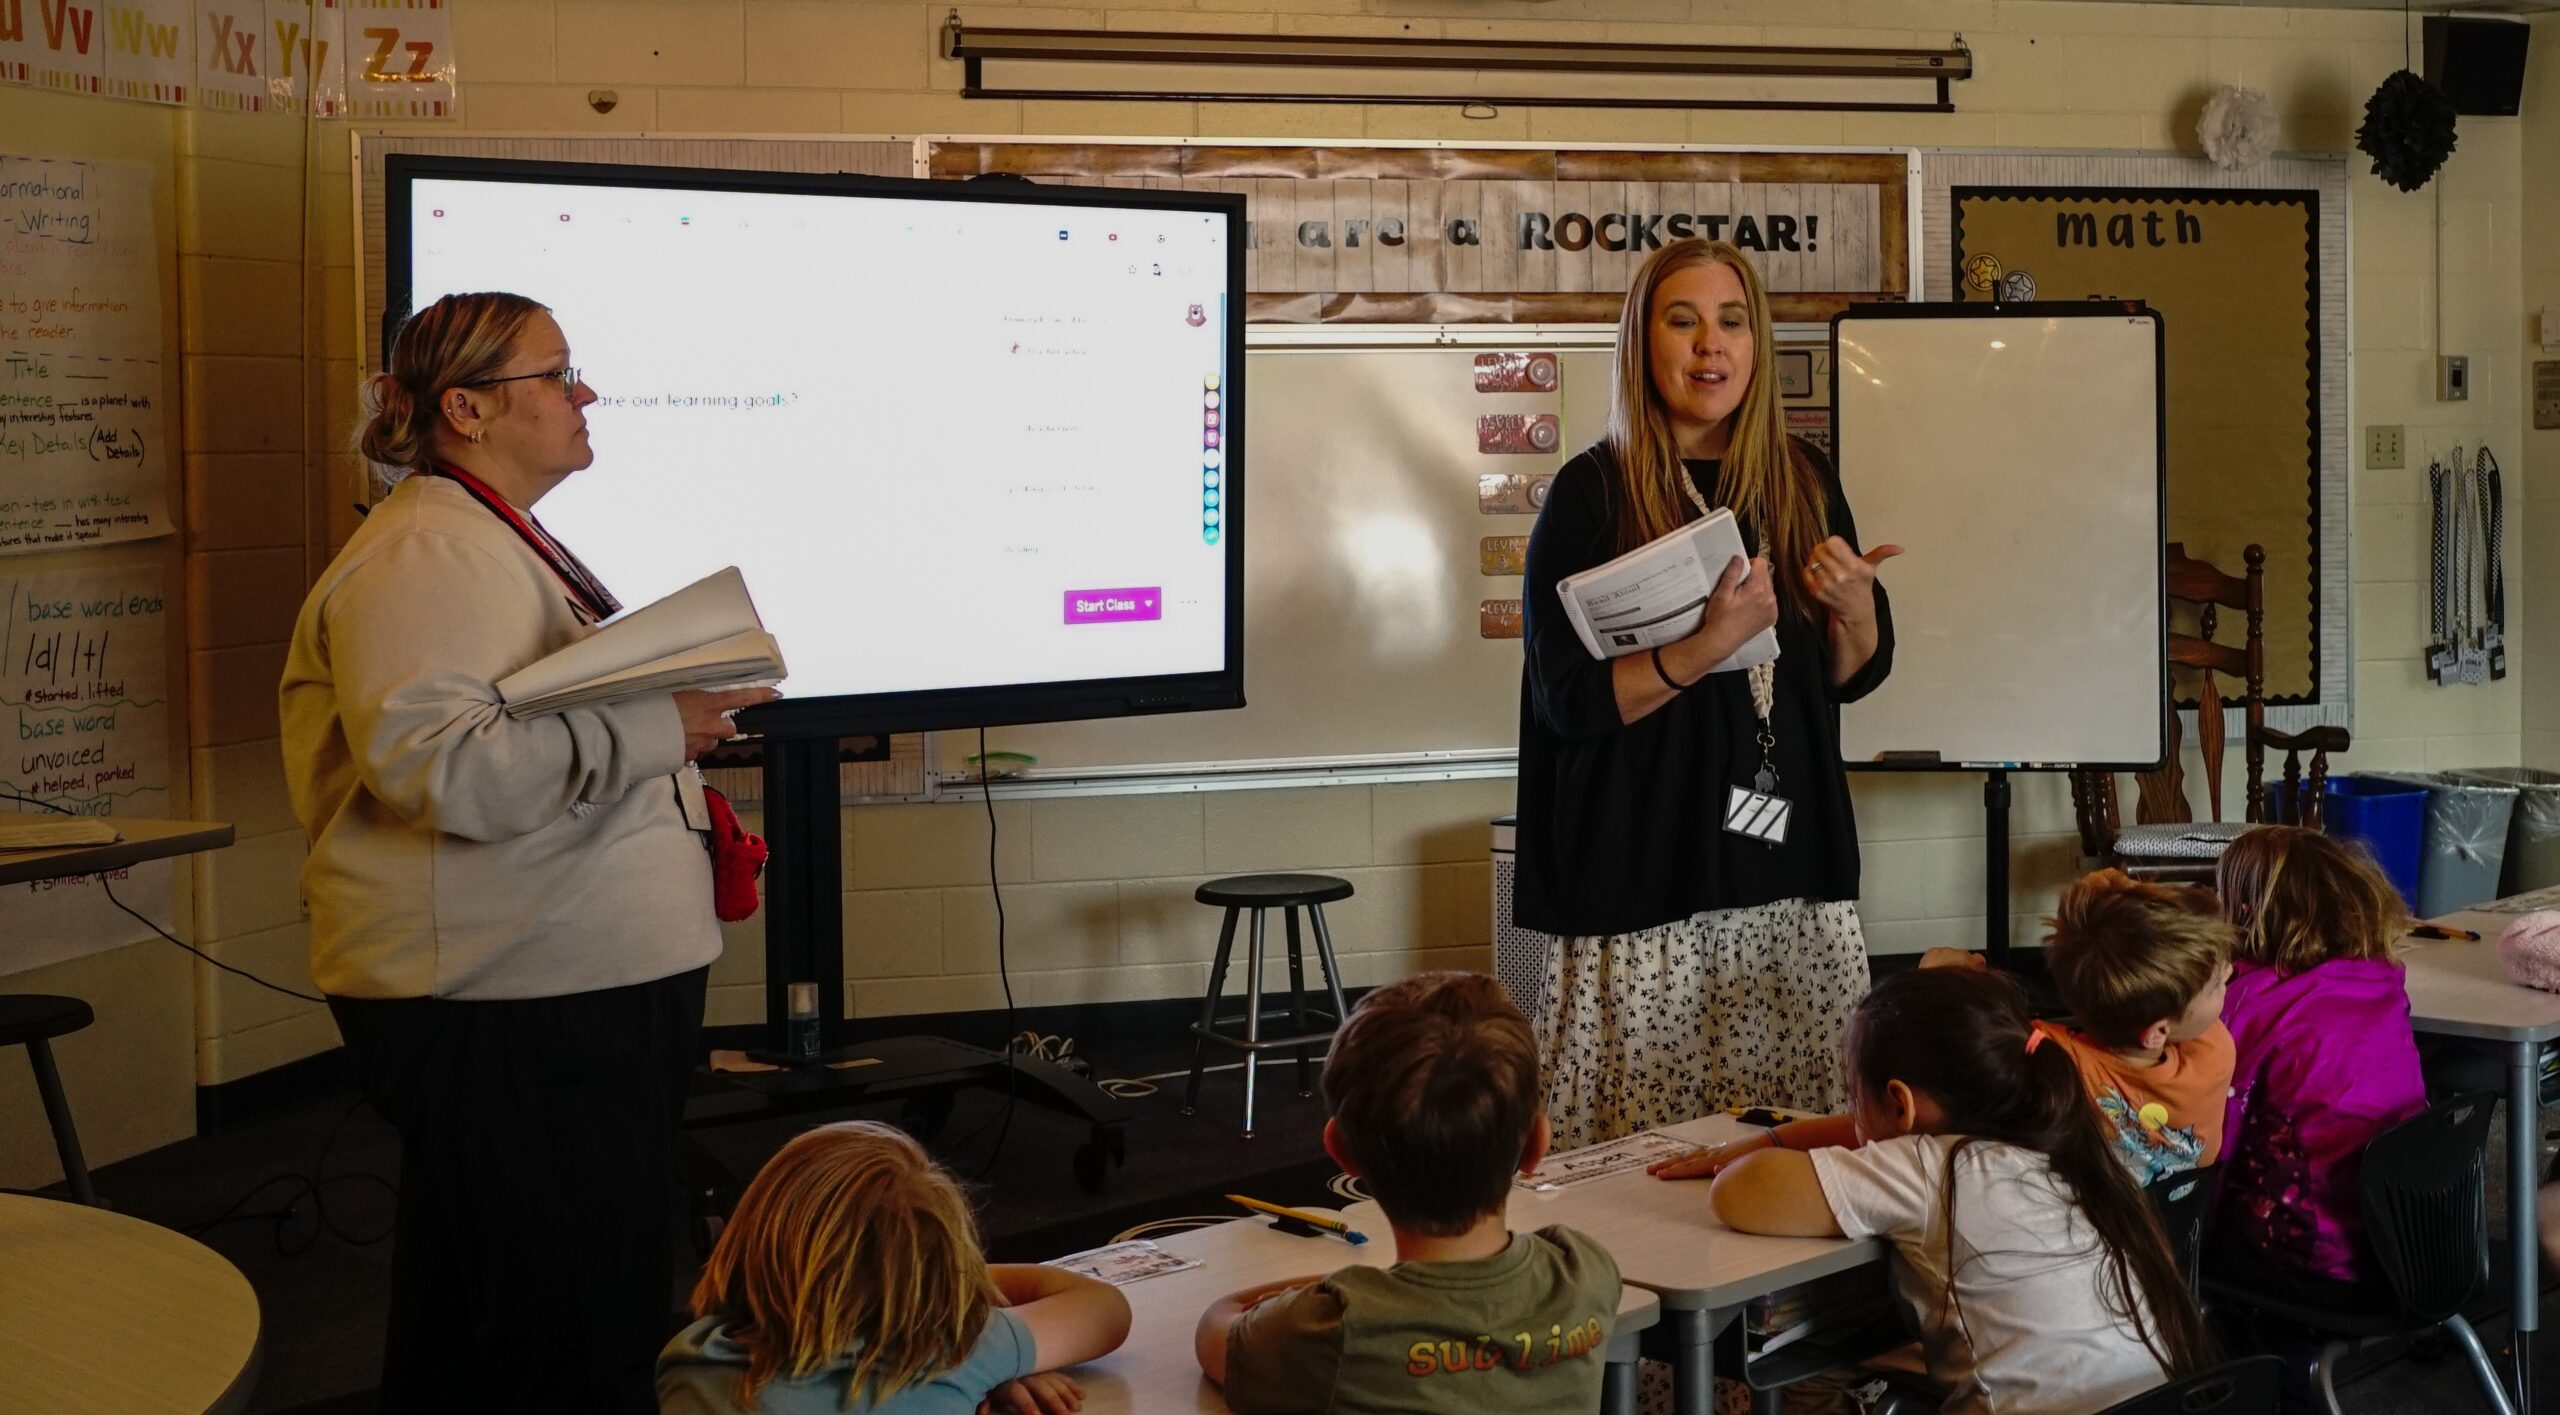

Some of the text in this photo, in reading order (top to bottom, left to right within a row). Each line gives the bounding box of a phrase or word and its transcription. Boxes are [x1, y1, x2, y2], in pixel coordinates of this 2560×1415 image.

[363, 27, 436, 83] Zz
[1297, 217, 1405, 248] are
[1446, 212, 1480, 247] a
[1518, 212, 1819, 252] ROCKSTAR!
[2056, 209, 2202, 249] math
[667, 393, 738, 410] learning
[28, 590, 164, 624] base word ends
[1076, 598, 1136, 613] Start Class
[19, 707, 116, 741] base word
[21, 738, 105, 775] unvoiced
